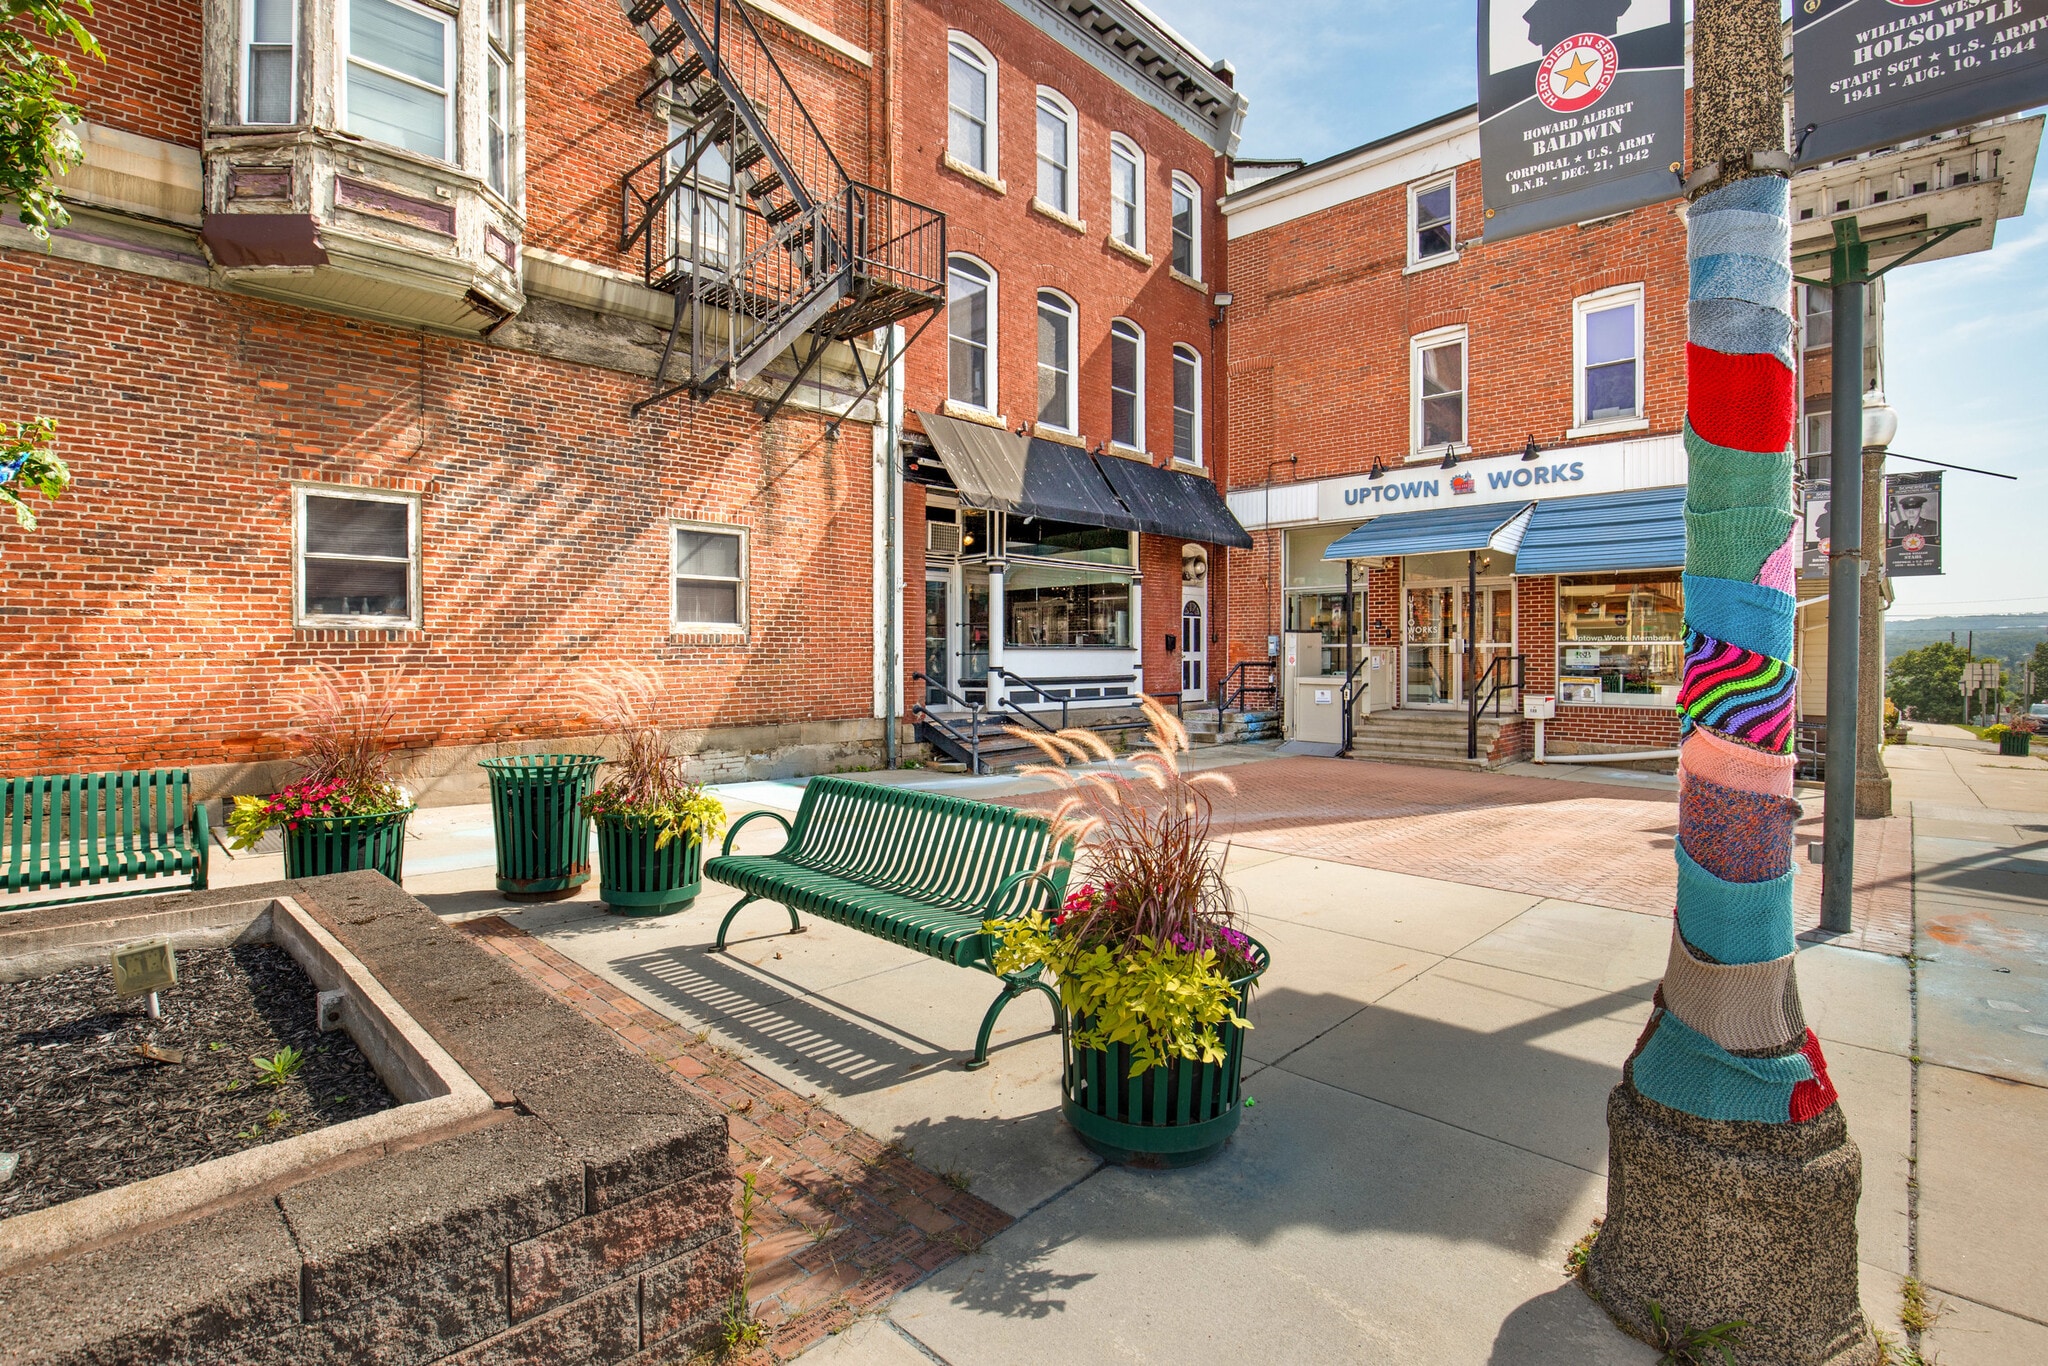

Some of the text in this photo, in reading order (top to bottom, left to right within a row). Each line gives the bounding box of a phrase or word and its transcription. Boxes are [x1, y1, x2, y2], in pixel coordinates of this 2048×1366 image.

[1853, 0, 2022, 66] HOLSOPPLE
[1855, 0, 1990, 44] WILLIAM WES
[1539, 36, 1615, 107] HERO DIED IN SERVICE
[1829, 15, 2048, 94] STAFF SGT U.S. ARMY
[1843, 86, 1882, 105] 1941
[1902, 65, 1946, 88] AUG.
[1954, 55, 1982, 72] 10,
[1990, 37, 2037, 61] 1944
[1523, 101, 1634, 142] HOWARD ALBERT
[1532, 118, 1623, 156] BALDWIN
[1505, 133, 1656, 182] CORPORAL U.S. ARMY
[1511, 177, 1548, 194] D.N.B.
[1561, 164, 1589, 181] DEC.
[1593, 159, 1613, 173] 21,
[1619, 148, 1650, 166] 1942
[1344, 461, 1584, 506] UPTOWN WORKS
[1408, 626, 1438, 634] WORKS
[1572, 634, 1603, 642] Uptown
